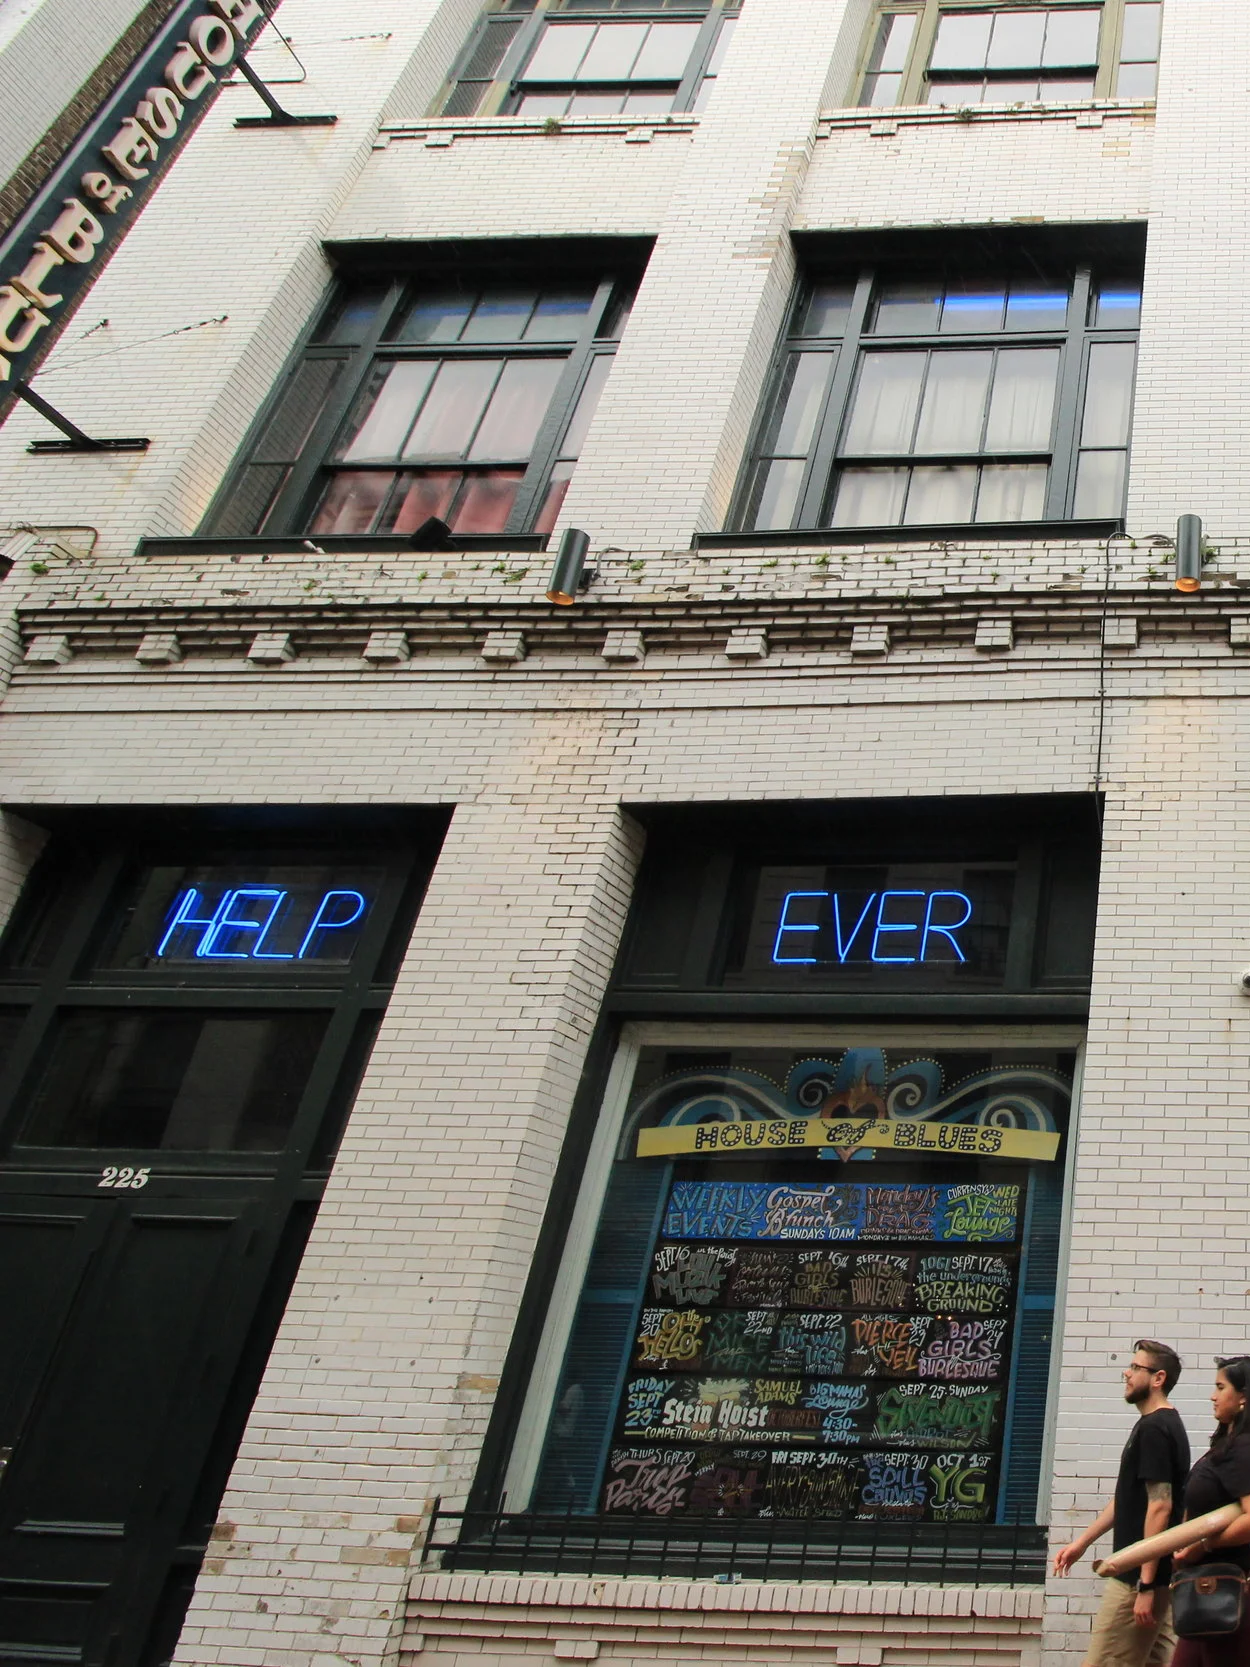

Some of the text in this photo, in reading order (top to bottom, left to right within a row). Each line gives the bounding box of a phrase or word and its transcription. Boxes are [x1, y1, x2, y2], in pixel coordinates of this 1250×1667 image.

[81, 172, 134, 214] of
[0, 198, 104, 382] BLU
[157, 888, 365, 959] HELP
[772, 890, 972, 962] EVER
[695, 1118, 1004, 1152] HOUSE of BLUES
[98, 1166, 151, 1189] 225
[671, 1186, 768, 1213] WEEKLY
[766, 1186, 835, 1213] Gospel
[993, 1185, 1020, 1198] WED
[948, 1194, 997, 1217] JET
[667, 1212, 752, 1236] EVENTS
[757, 1208, 837, 1237] Brunch
[866, 1207, 930, 1229] DRAG
[944, 1207, 1014, 1240] Lounge
[654, 1246, 690, 1272] SEPT 16
[707, 1246, 718, 1255] the
[805, 1262, 832, 1273] BAD
[979, 1256, 993, 1272] 17
[795, 1272, 840, 1287] GIRLS
[917, 1272, 936, 1283] the
[790, 1287, 847, 1307] BURLESQUE
[850, 1278, 910, 1308] BURLESQUE
[914, 1281, 1008, 1303] BREAKING
[927, 1299, 993, 1312] GROUND
[642, 1313, 664, 1325] SEPT
[746, 1311, 767, 1322] SEPT
[824, 1314, 843, 1329] 22
[910, 1316, 934, 1330] SEPT
[983, 1319, 1007, 1331] SEPT
[640, 1324, 660, 1337] 20
[851, 1318, 912, 1348] PIERCE
[909, 1328, 927, 1347] 23
[951, 1321, 984, 1340] BAD
[986, 1330, 1003, 1349] 24
[879, 1346, 918, 1371] VEIL
[928, 1340, 992, 1358] GIRLS
[918, 1357, 1000, 1379] BURLESQUE
[628, 1377, 676, 1393] FRIDAY
[754, 1378, 803, 1395] SAMUEL
[899, 1383, 988, 1398] SEPT SUNDAY
[628, 1391, 665, 1410] SEPT
[755, 1391, 797, 1406] ADAMS
[801, 1395, 869, 1419] Lounge
[662, 1398, 769, 1429] Stein Hoist
[644, 1426, 707, 1441] COMPETITION
[739, 1429, 791, 1442] TAKEOVER
[916, 1435, 976, 1449] WILSON
[629, 1448, 662, 1464] THURS
[663, 1450, 683, 1467] SEPT
[680, 1451, 696, 1469] 29
[751, 1450, 768, 1462] 29
[771, 1451, 788, 1464] FRI
[911, 1454, 929, 1471] 30
[936, 1453, 991, 1468] OCT 1ST
[869, 1466, 925, 1489] SPILL
[928, 1464, 988, 1504] YG
